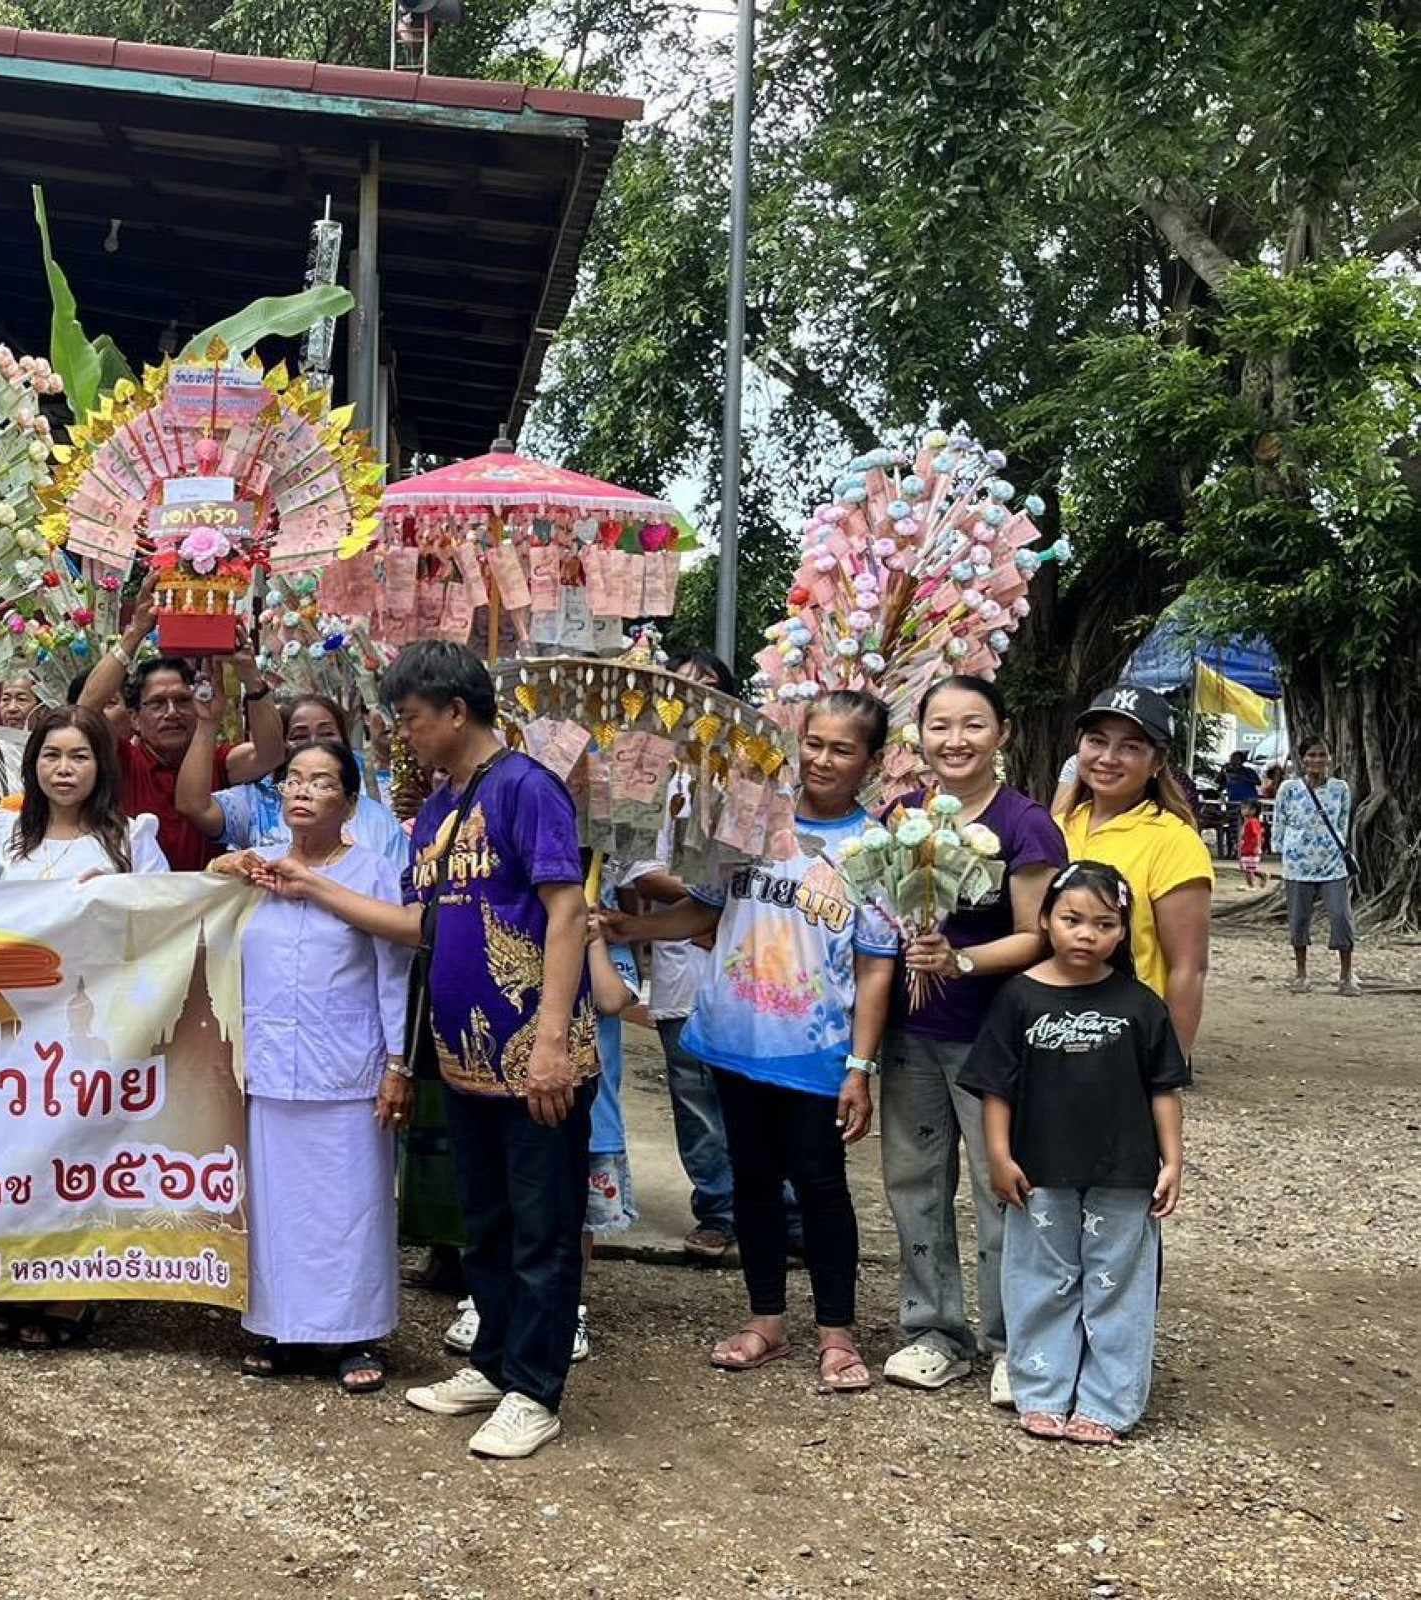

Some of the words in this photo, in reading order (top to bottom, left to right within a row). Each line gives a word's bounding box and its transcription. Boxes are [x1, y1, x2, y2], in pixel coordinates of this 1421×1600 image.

[1110, 689, 1139, 711] NY
[53, 1152, 237, 1205] ๒๕๖๘
[11, 1248, 230, 1287] หลวงพ่อธัมมชโย
